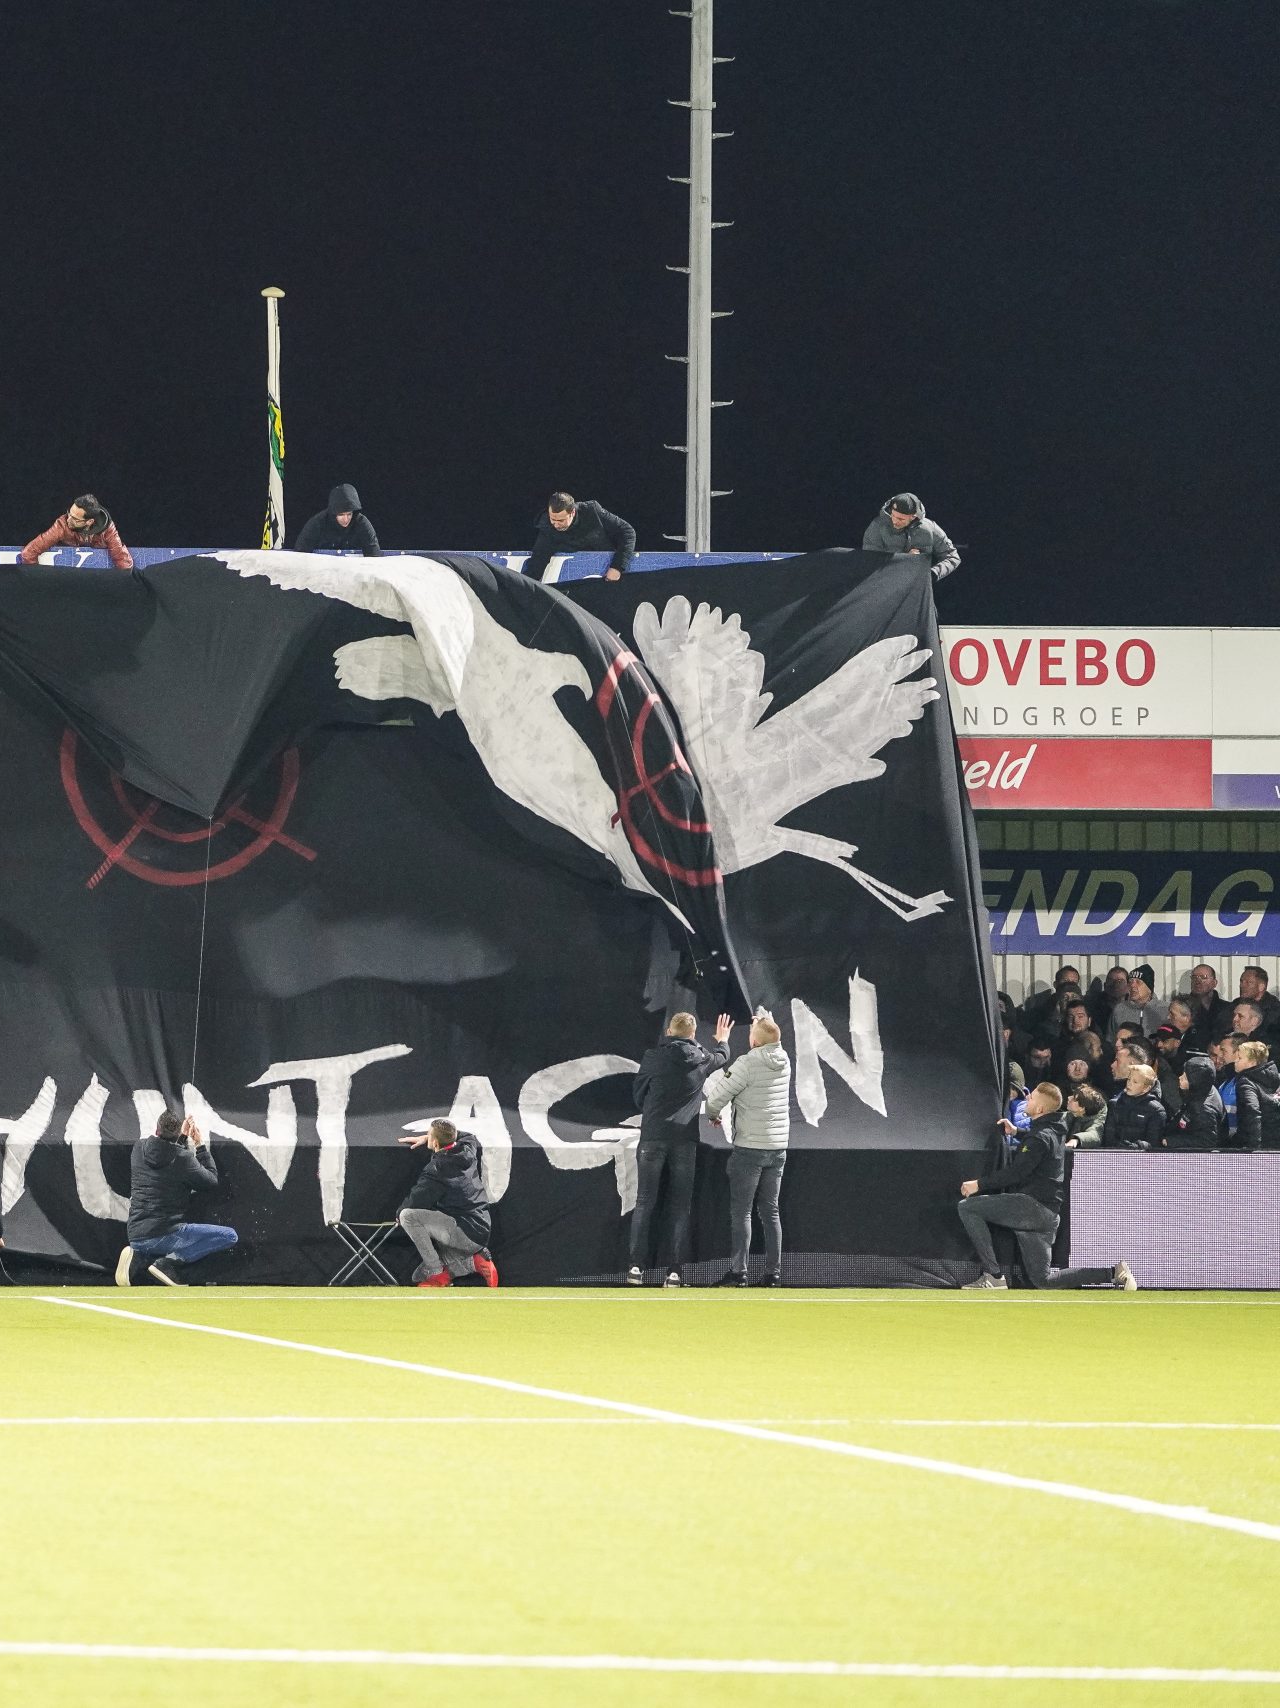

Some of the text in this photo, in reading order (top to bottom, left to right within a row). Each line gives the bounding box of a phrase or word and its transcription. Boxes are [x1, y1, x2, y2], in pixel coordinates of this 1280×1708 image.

[940, 638, 1156, 686] OVEBO
[963, 706, 1150, 726] NDGROEP
[960, 744, 1038, 790] eld
[402, 967, 888, 1216] AGN
